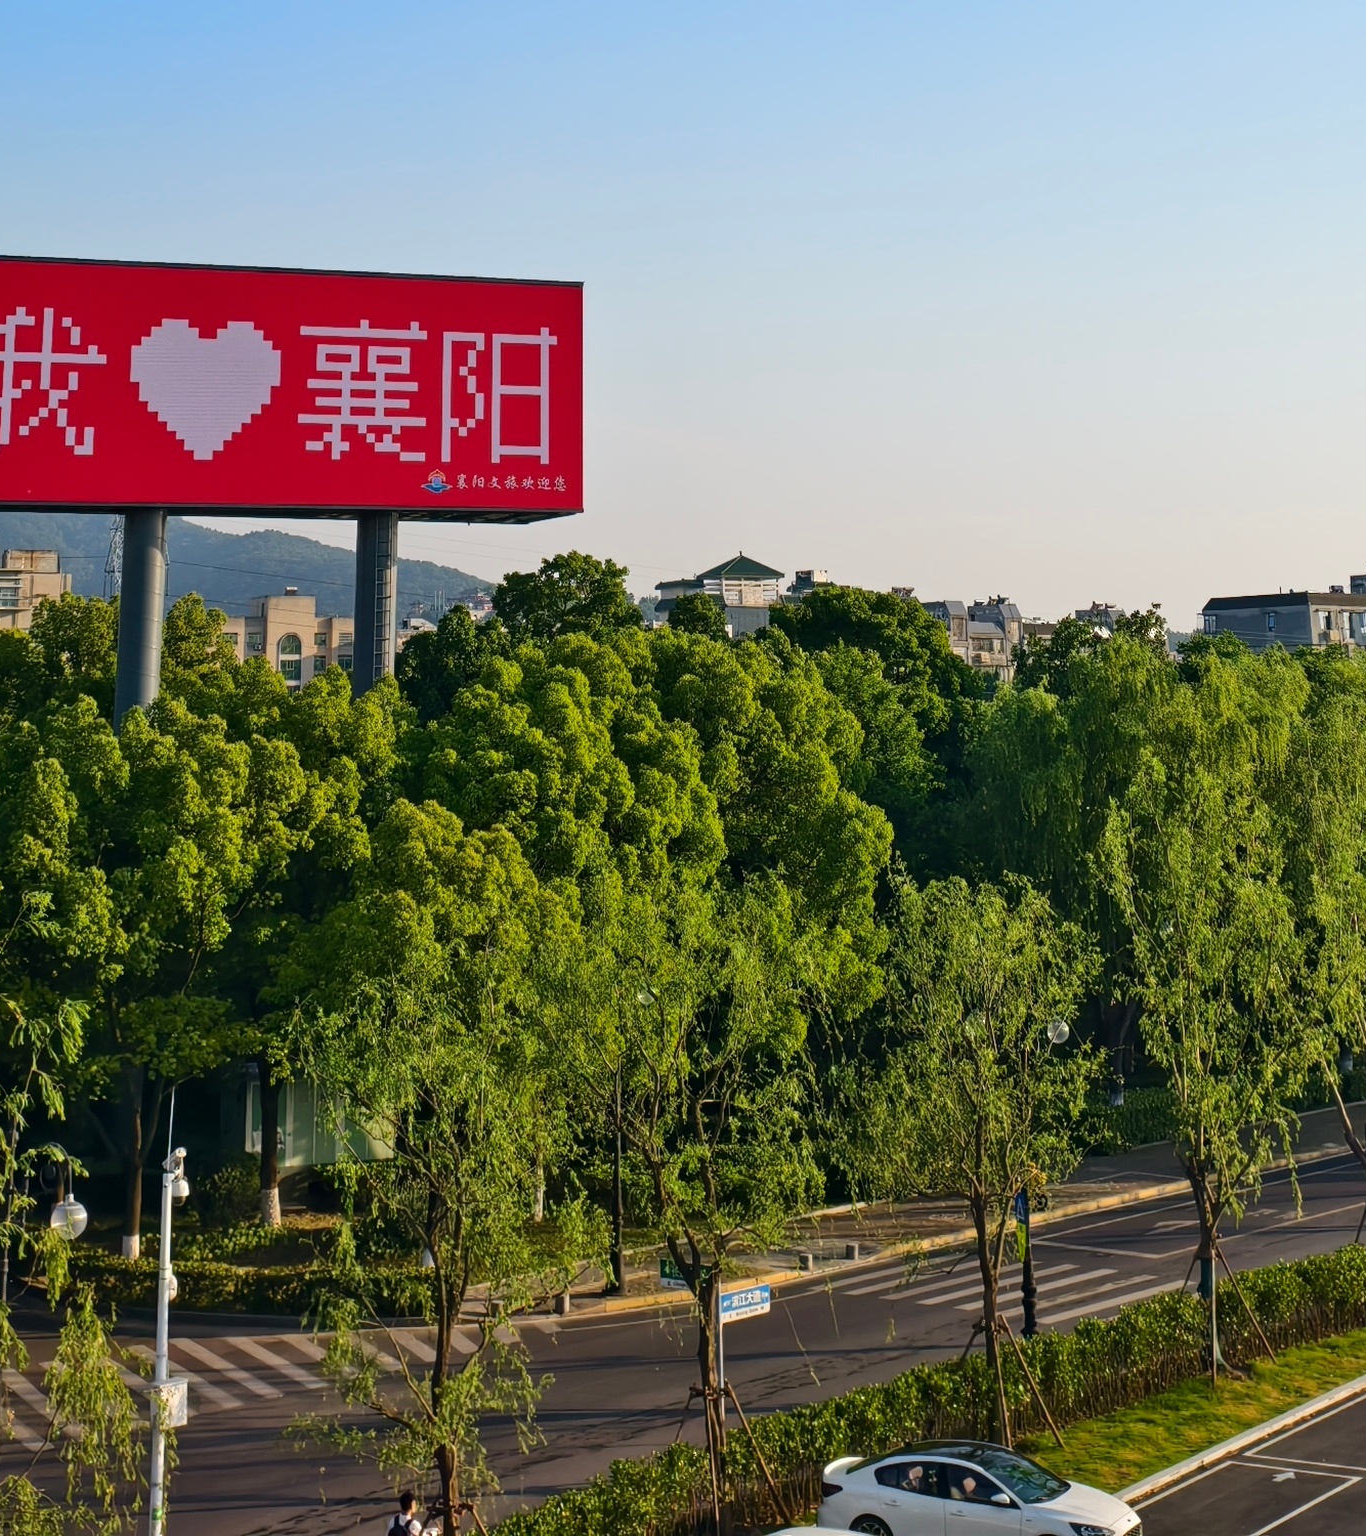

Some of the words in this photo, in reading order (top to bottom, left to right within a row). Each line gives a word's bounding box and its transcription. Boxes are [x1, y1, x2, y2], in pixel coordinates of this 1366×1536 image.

[298, 319, 559, 464] 襄阳
[456, 473, 567, 492] 襄阳文旅欢迎您
